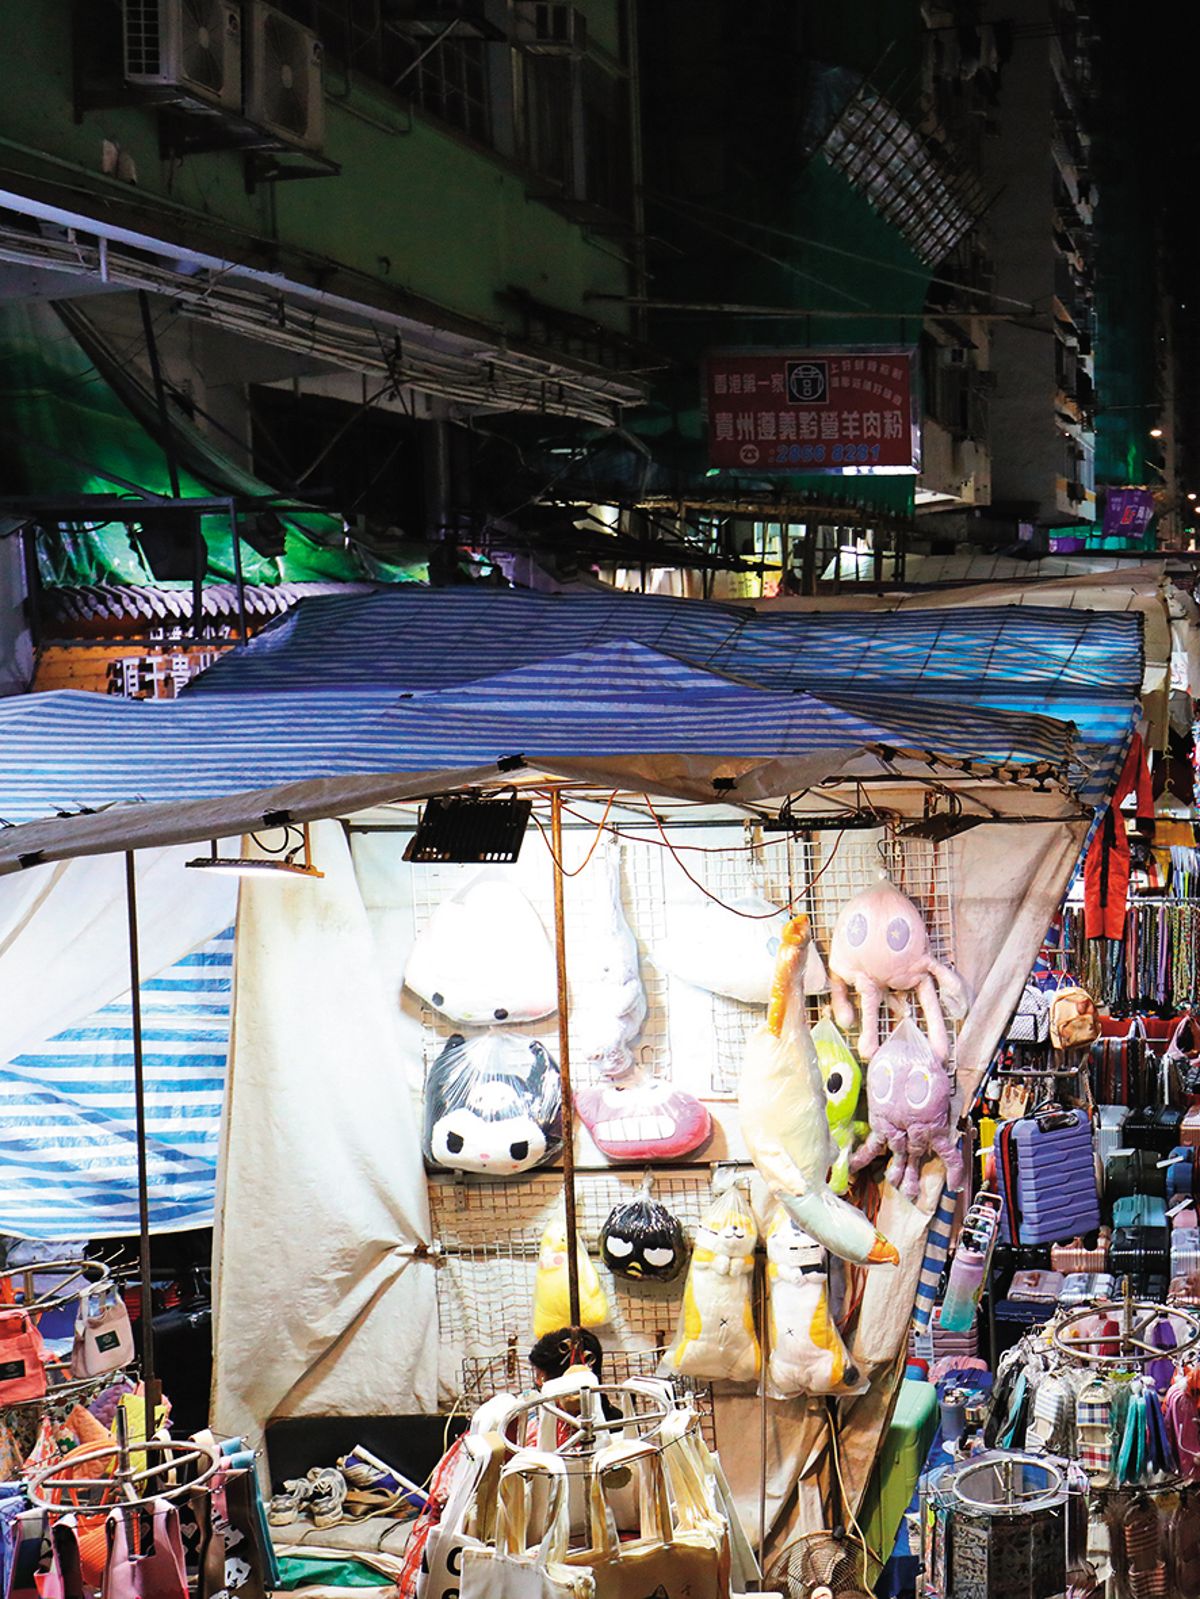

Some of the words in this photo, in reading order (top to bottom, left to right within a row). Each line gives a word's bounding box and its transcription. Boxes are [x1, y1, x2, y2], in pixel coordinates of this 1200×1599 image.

[714, 373, 784, 394] 香港第一家
